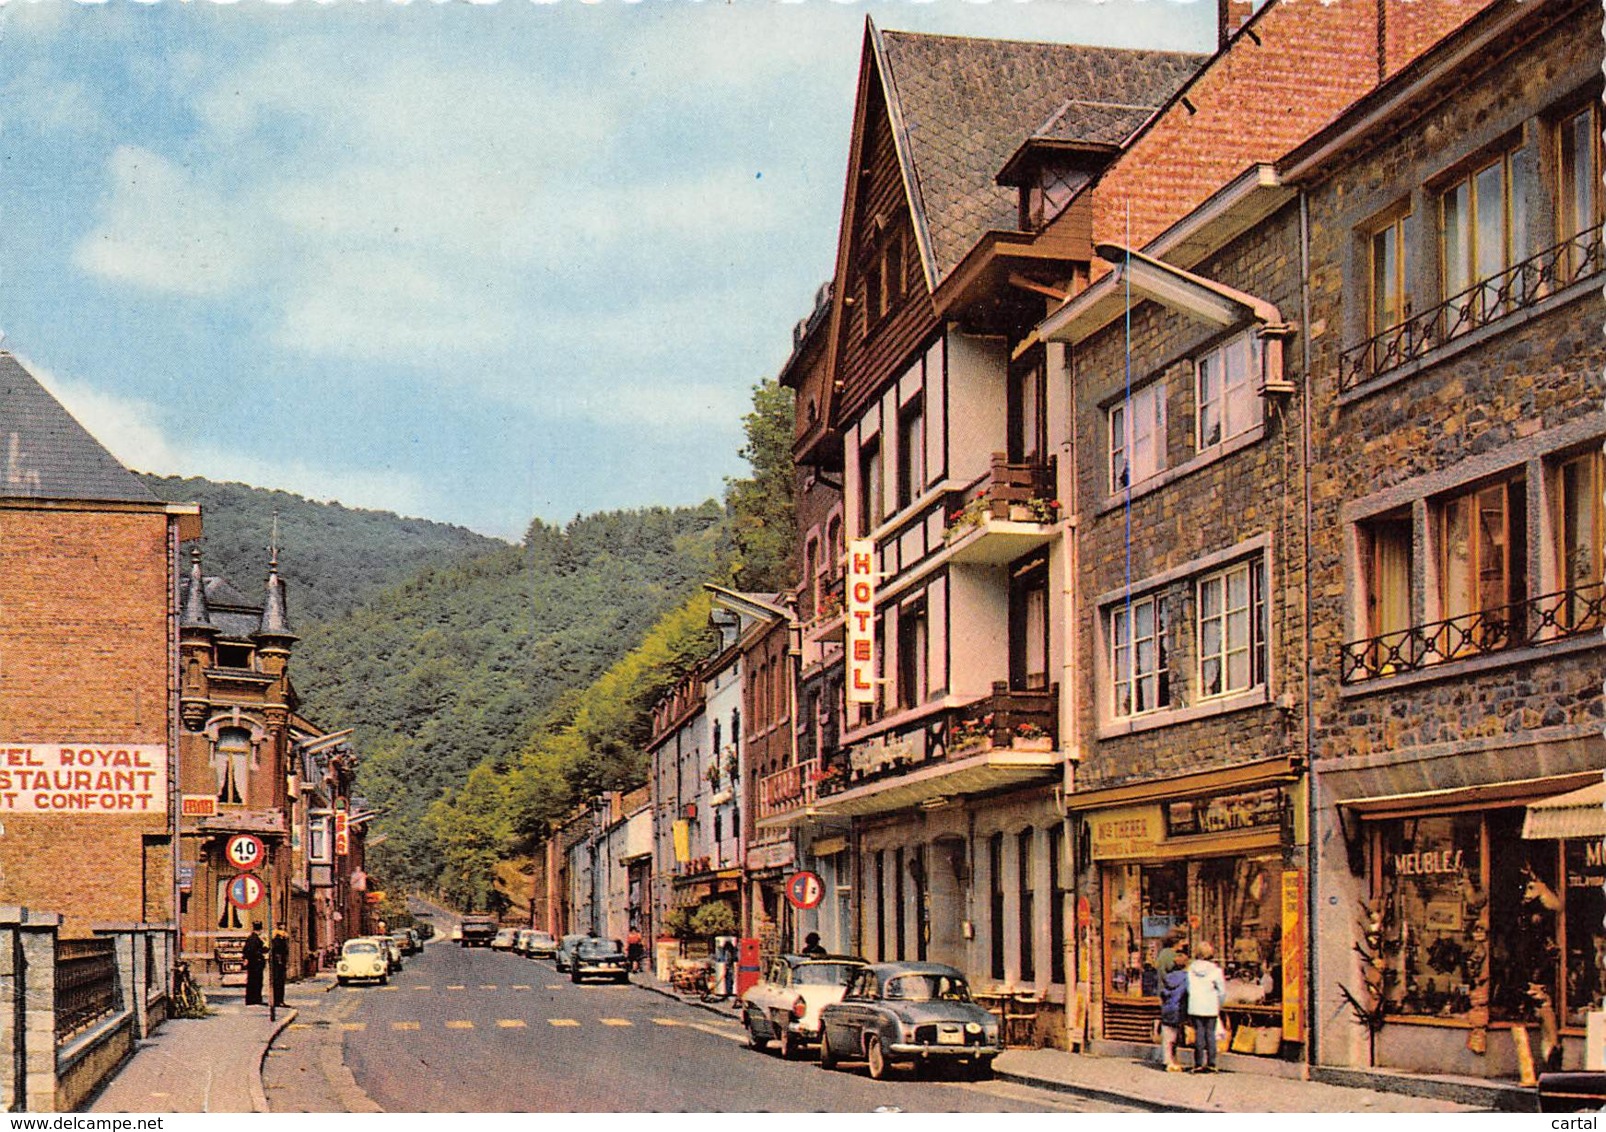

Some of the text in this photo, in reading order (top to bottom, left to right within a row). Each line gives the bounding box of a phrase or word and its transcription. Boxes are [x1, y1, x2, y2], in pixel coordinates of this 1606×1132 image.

[853, 552, 871, 690] HOTEL
[0, 749, 152, 767] EL ROYAL
[0, 770, 156, 791] STAURANT
[0, 793, 153, 810] T CONFORT
[234, 841, 256, 855] 40
